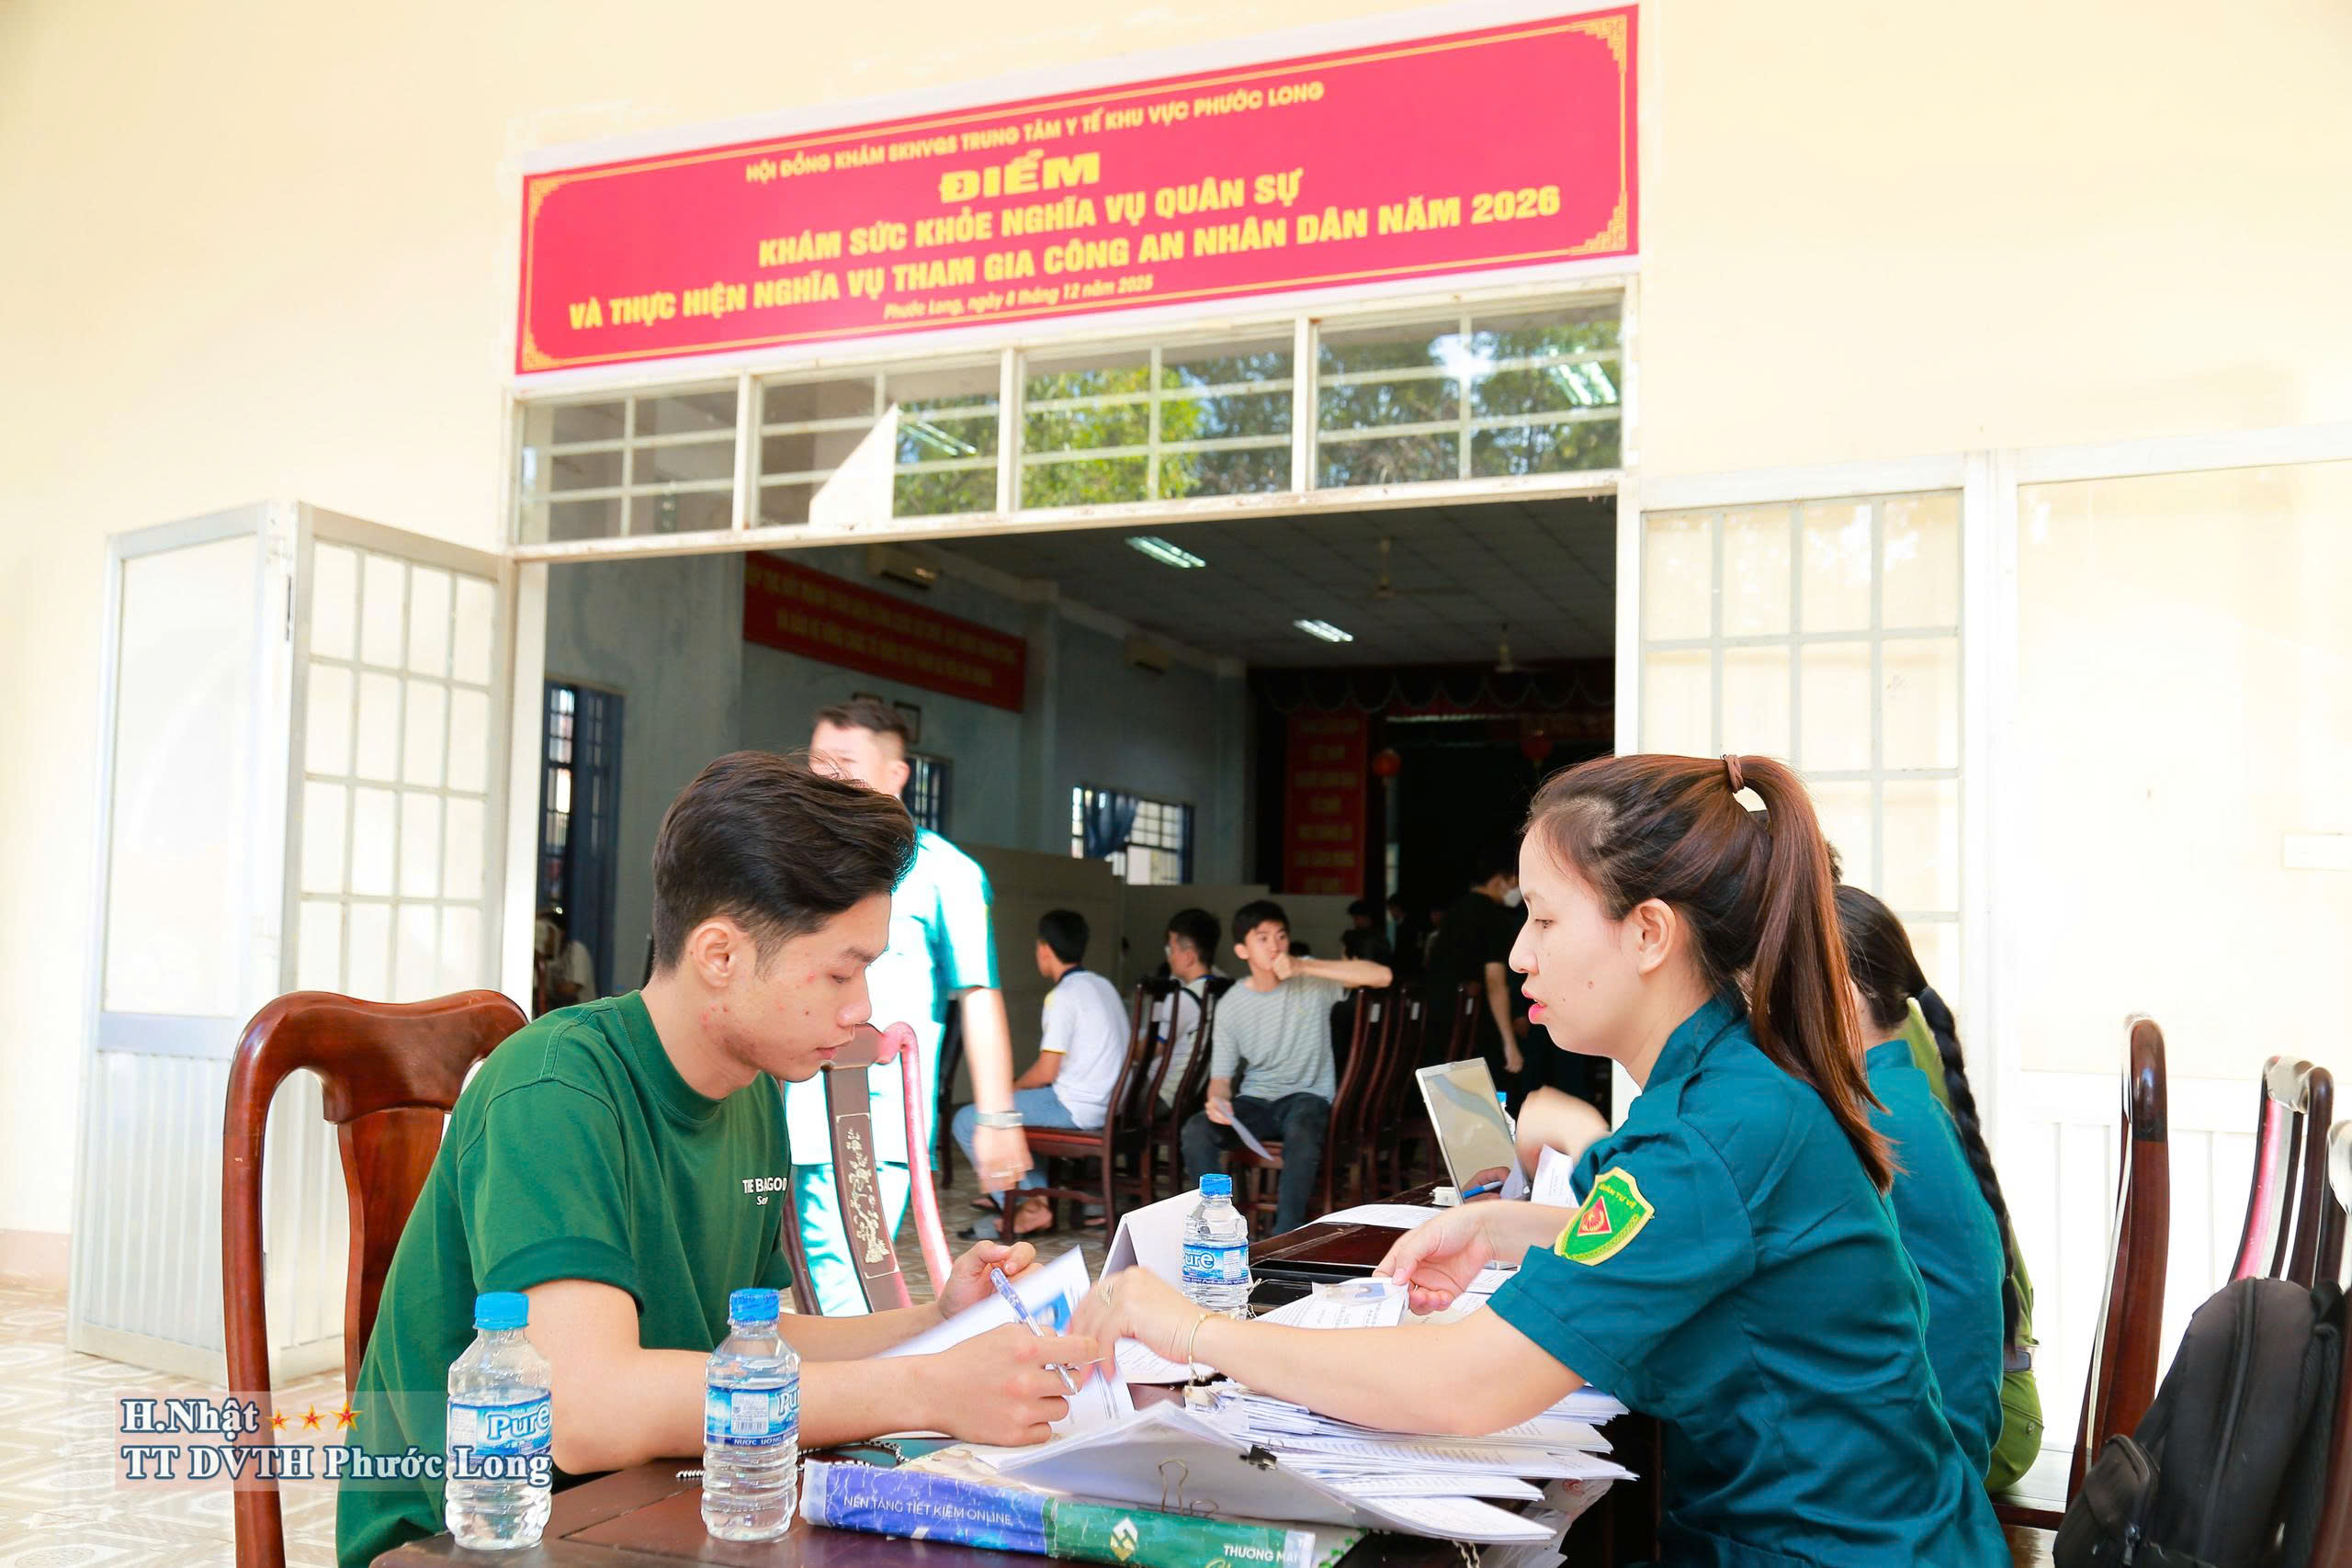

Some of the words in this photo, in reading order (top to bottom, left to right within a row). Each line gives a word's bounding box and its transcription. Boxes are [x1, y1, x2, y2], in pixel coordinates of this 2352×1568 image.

[746, 158, 777, 184] HỘI
[834, 143, 885, 169] KHÁM
[960, 126, 1021, 152] TRUNG
[1023, 118, 1061, 142] TÂM
[1066, 117, 1079, 137] Y
[1081, 107, 1104, 134] TẾ
[1105, 107, 1145, 130] KHU
[1148, 100, 1190, 127] VỰC
[1193, 89, 1263, 118] PHƯỚC
[1268, 81, 1325, 107] LONG
[937, 150, 1101, 204] ĐIỂM
[758, 230, 842, 268] KHÁM
[848, 220, 908, 257] SỨC
[914, 206, 993, 248] KHỎE
[1001, 195, 1097, 237] NGHĨA
[1104, 191, 1147, 228] VỤ
[1155, 176, 1246, 219] QUÂN
[1254, 167, 1305, 209] SỰ
[568, 298, 604, 331] VÀ
[609, 291, 677, 327] THỰC
[683, 282, 748, 320] HIỆN
[753, 270, 842, 310] NGHĨA
[846, 266, 886, 301] VỤ
[891, 255, 977, 293] THAM
[984, 249, 1036, 282] GIA
[1044, 237, 1130, 275] CÔNG
[1137, 231, 1185, 265] AN
[1193, 216, 1287, 257] NHÂN
[1296, 206, 1368, 244] DÂN
[1378, 195, 1462, 235] NĂM
[1469, 186, 1561, 225] 2026
[1063, 283, 1080, 300] 12
[1082, 279, 1115, 298] năm
[1183, 1251, 1215, 1269] ure
[487, 1404, 551, 1440] Pure
[967, 1507, 1012, 1526] ONLINE
